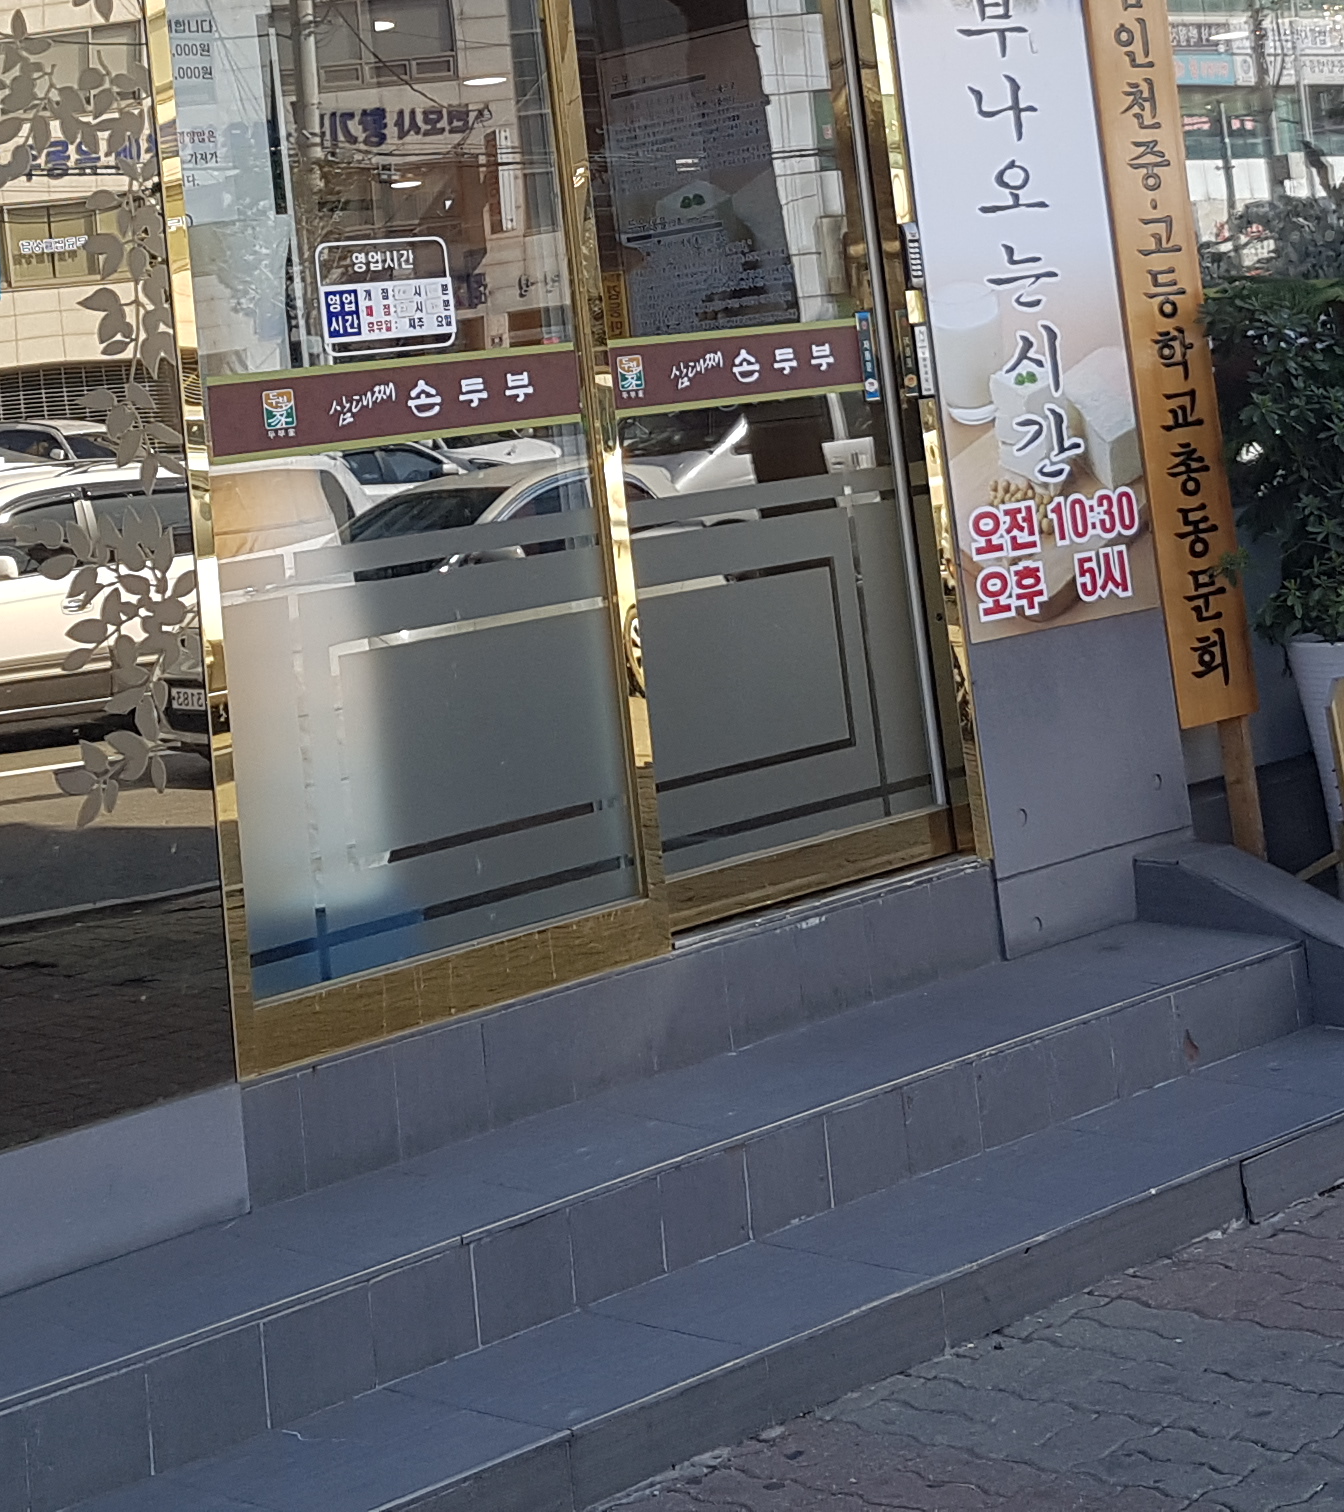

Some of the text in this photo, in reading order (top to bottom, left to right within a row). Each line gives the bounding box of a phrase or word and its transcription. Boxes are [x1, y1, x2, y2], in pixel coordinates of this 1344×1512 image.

[352, 250, 414, 272] 영업시간
[327, 293, 356, 313] 영업
[330, 314, 359, 334] 시간
[671, 351, 723, 390] 삼대째
[732, 343, 835, 383] 손두부
[329, 382, 396, 426] 삼대째
[408, 372, 534, 418] 손두부
[971, 487, 1137, 559] 오전 10:30
[979, 547, 1132, 620] 오후 5시
